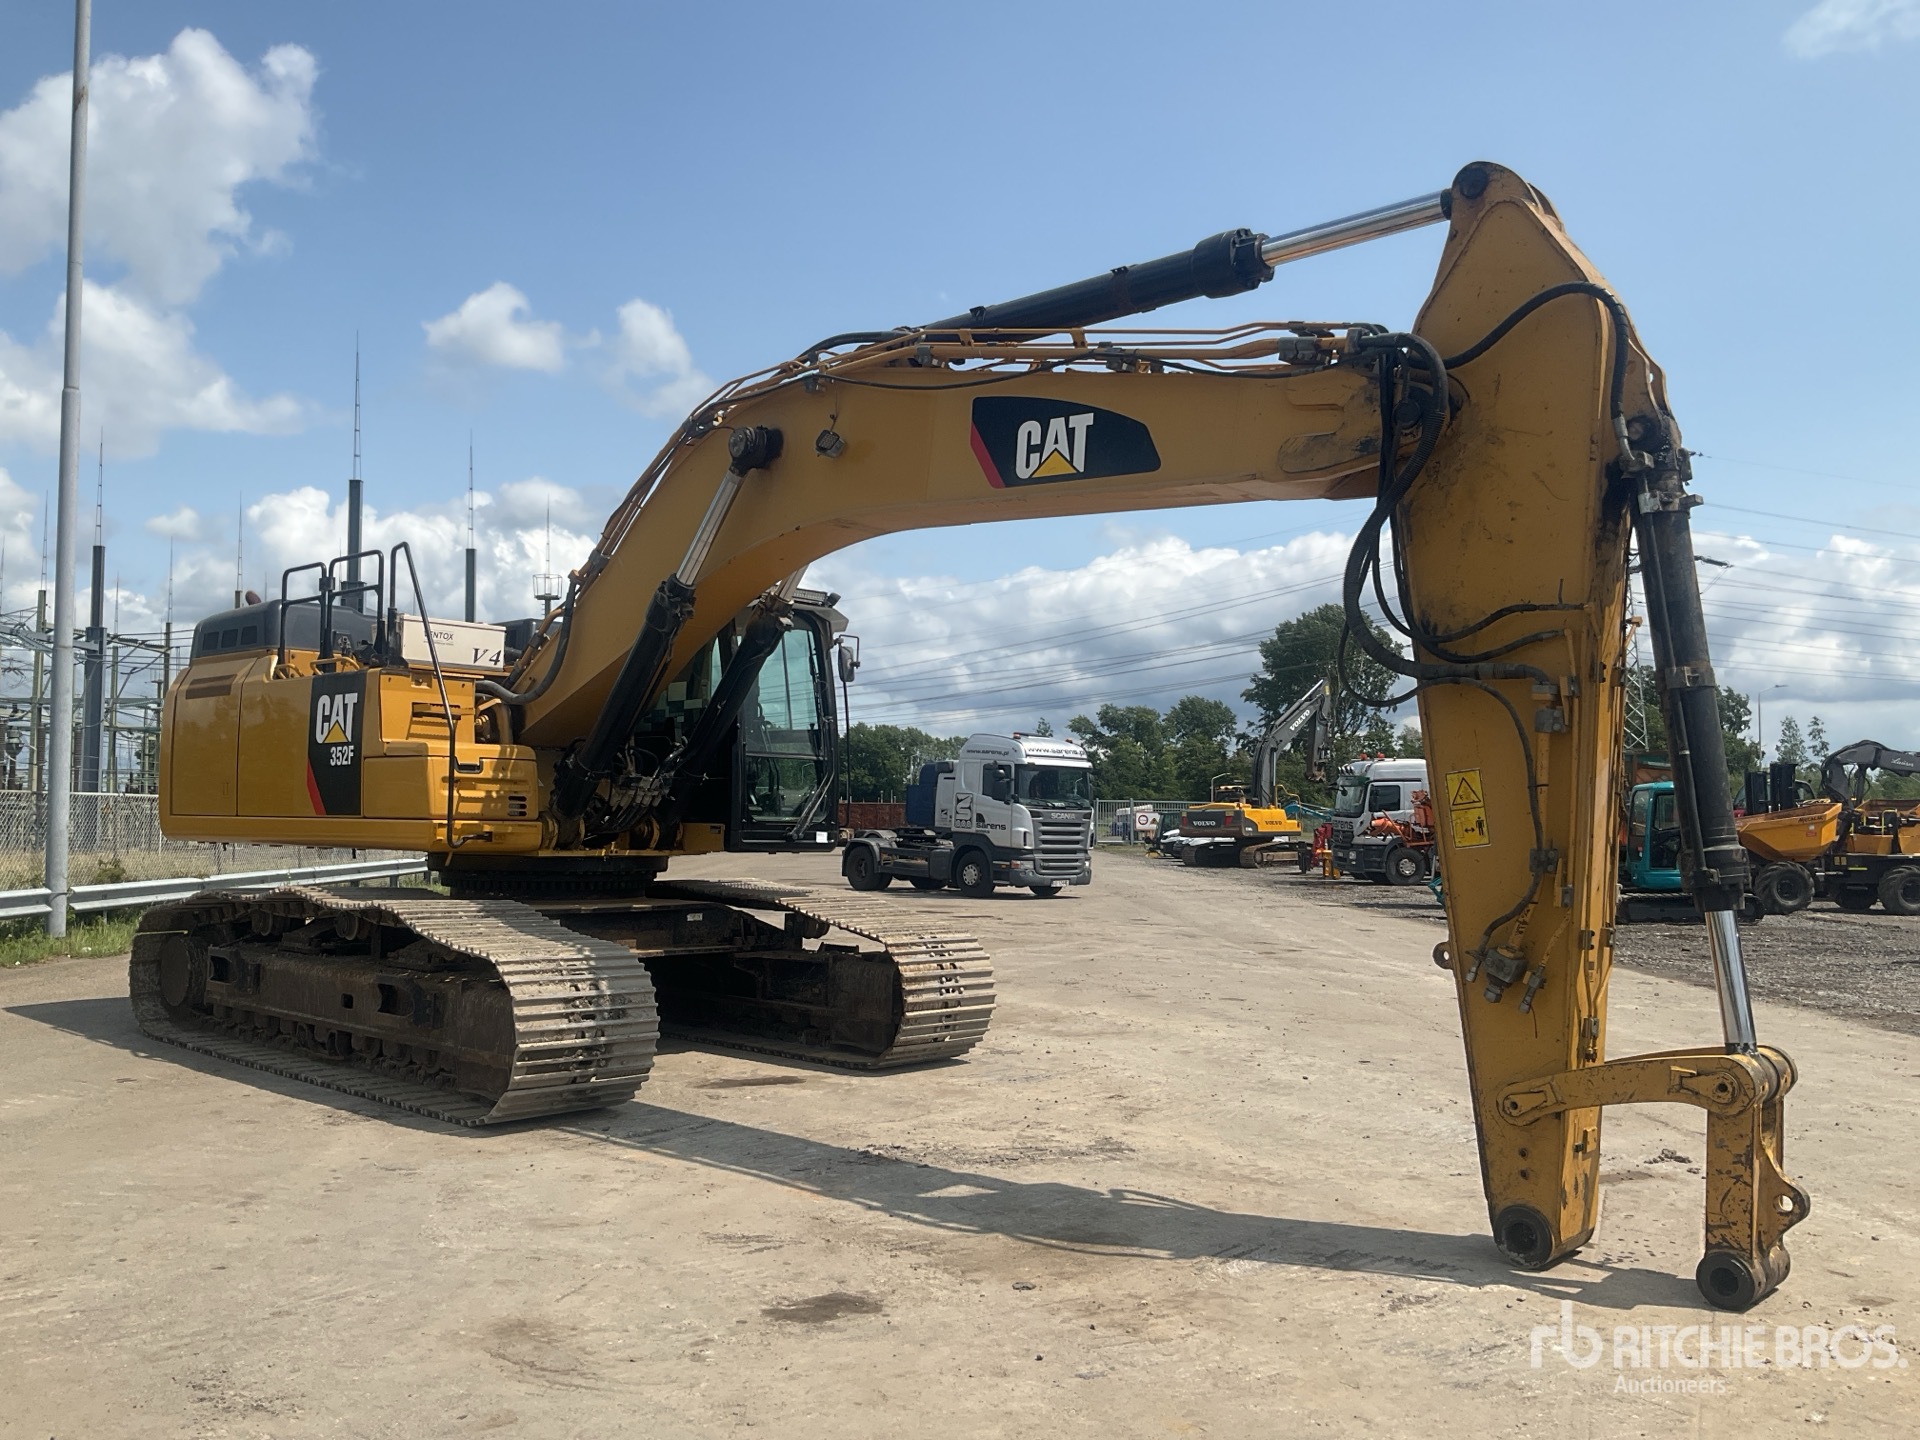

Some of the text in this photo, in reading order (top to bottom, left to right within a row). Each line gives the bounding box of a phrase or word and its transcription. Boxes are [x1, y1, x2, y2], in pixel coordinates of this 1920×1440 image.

[1015, 412, 1094, 479] CAT
[316, 693, 358, 744] CAT
[1289, 709, 1310, 730] VOLVO
[330, 745, 354, 766] 352F
